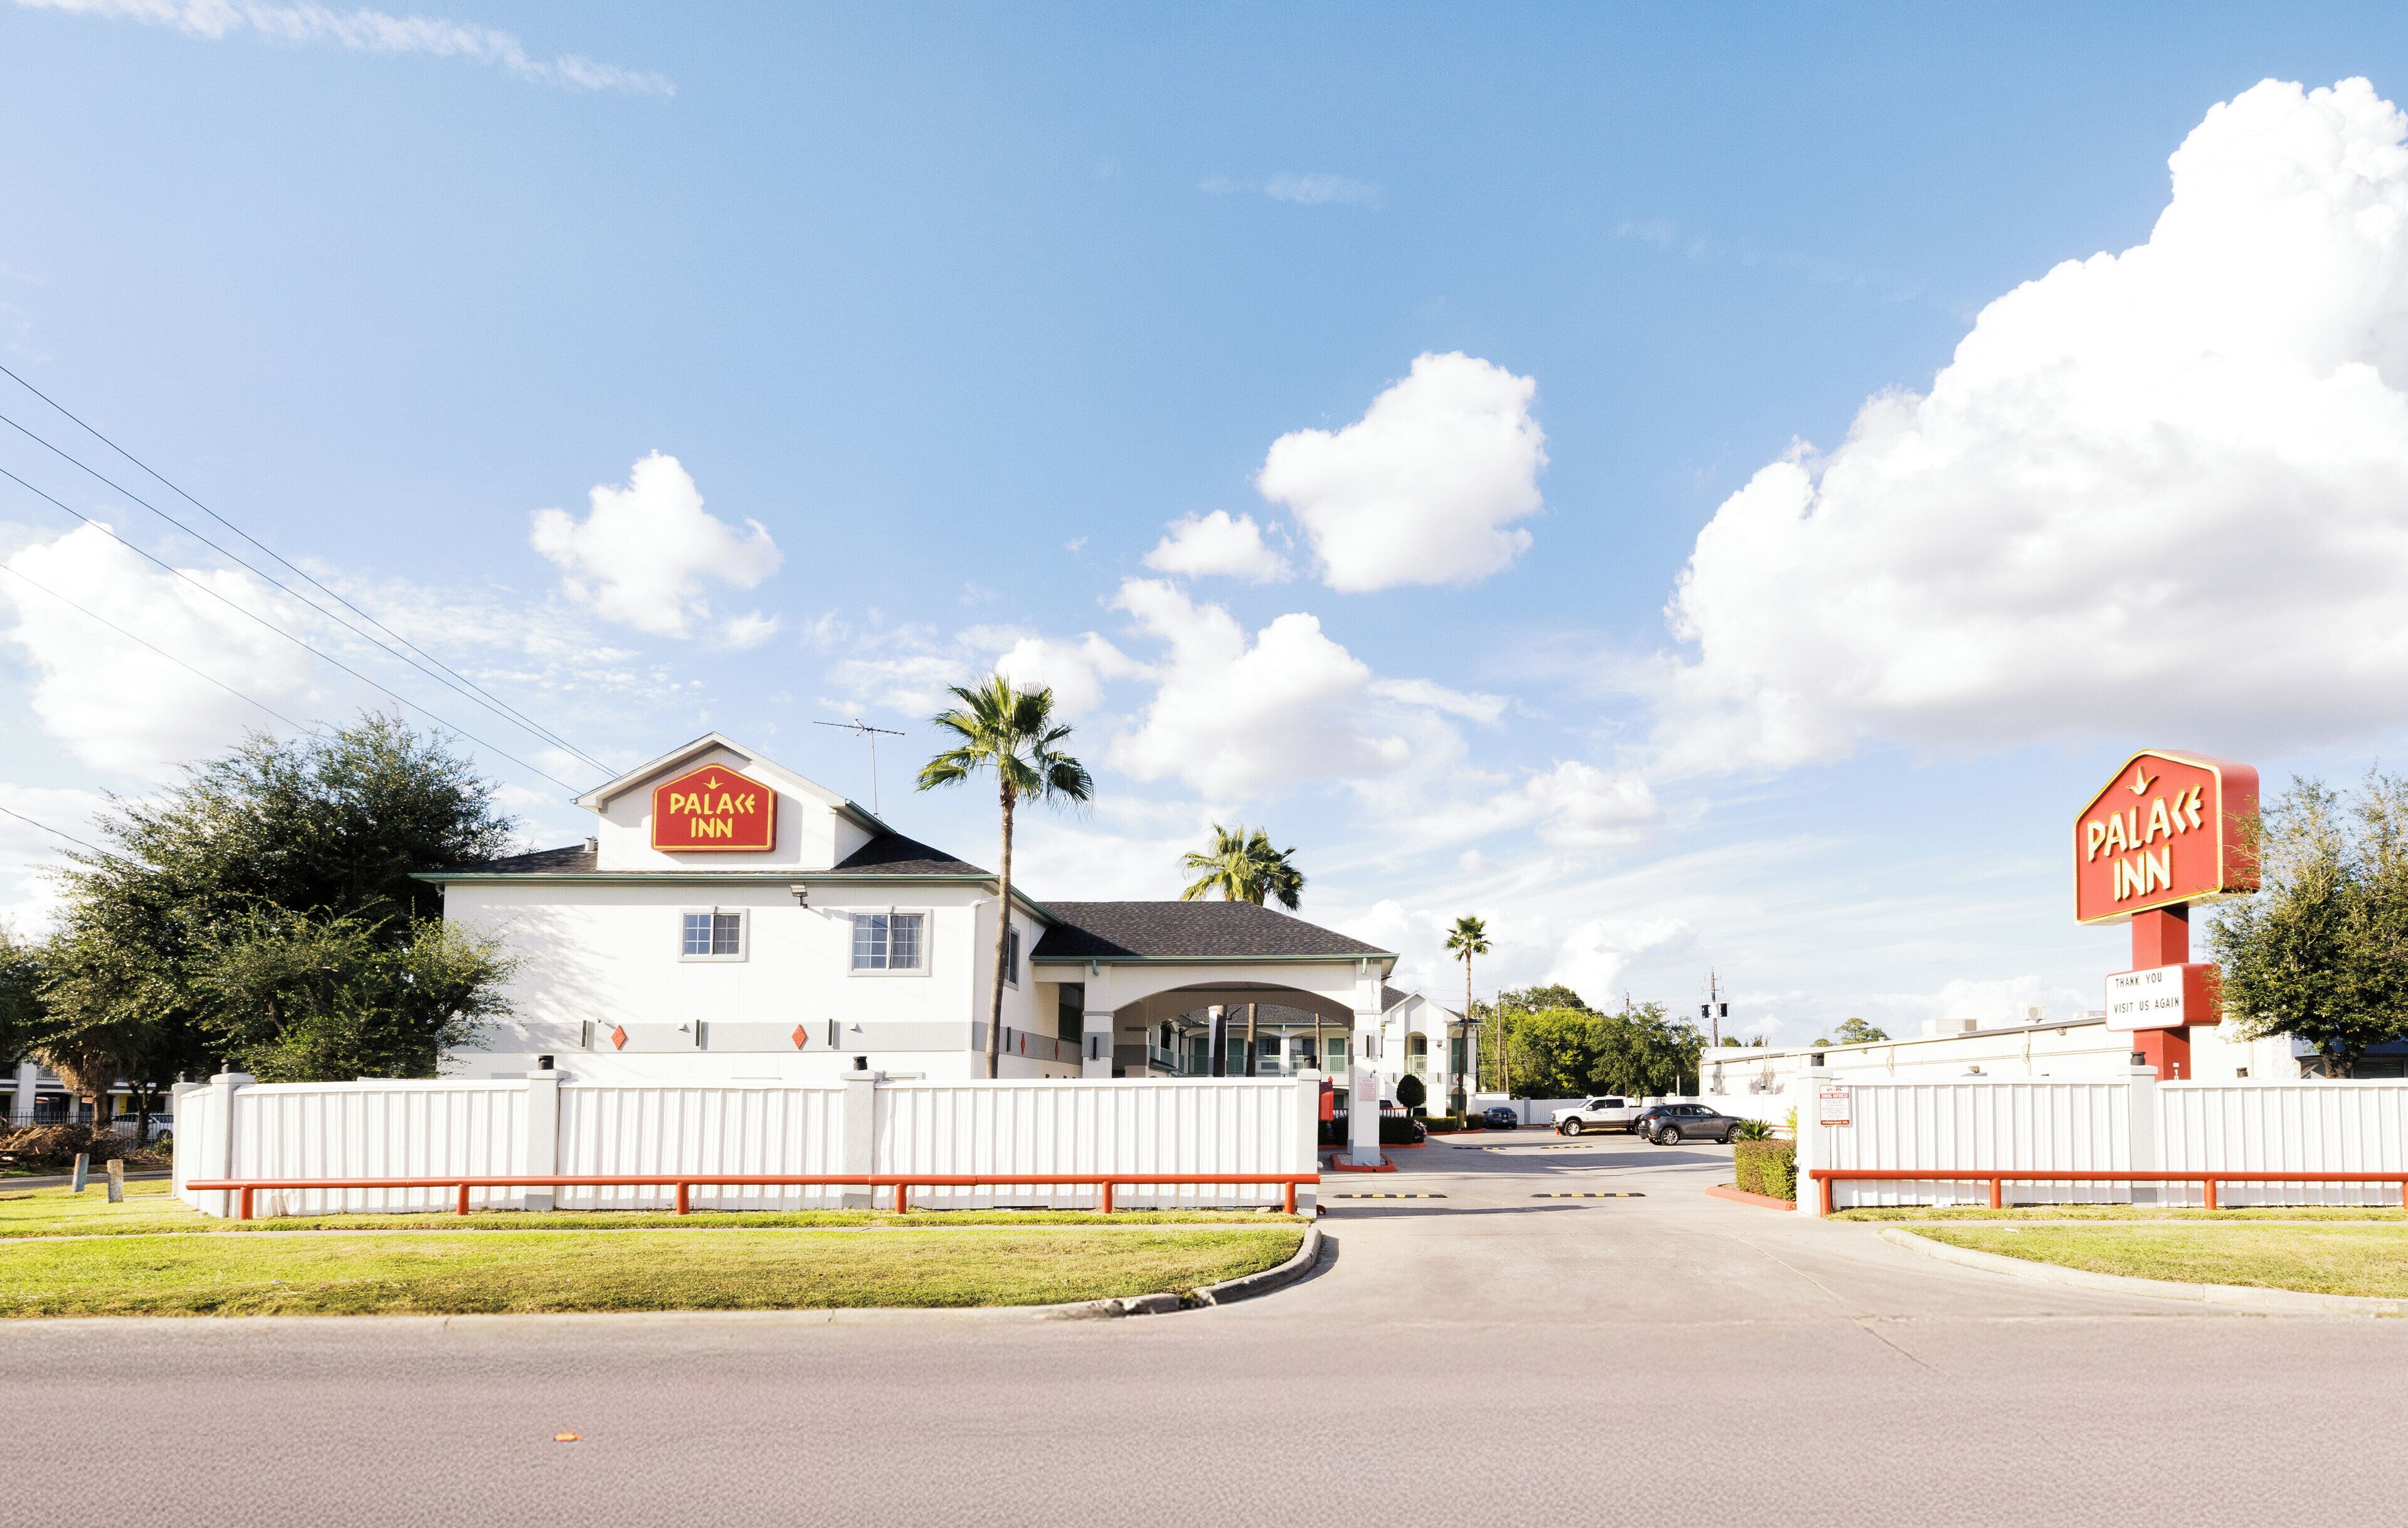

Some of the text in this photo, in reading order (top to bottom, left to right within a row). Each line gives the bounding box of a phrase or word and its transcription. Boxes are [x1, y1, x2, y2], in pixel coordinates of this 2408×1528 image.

[670, 793, 755, 814] PALACE
[690, 817, 733, 838] INN
[2087, 783, 2204, 863] PALACE
[2113, 843, 2172, 902] INN
[2115, 972, 2162, 988] THANK YOU
[2114, 997, 2179, 1014] VISIT US AGAIN
